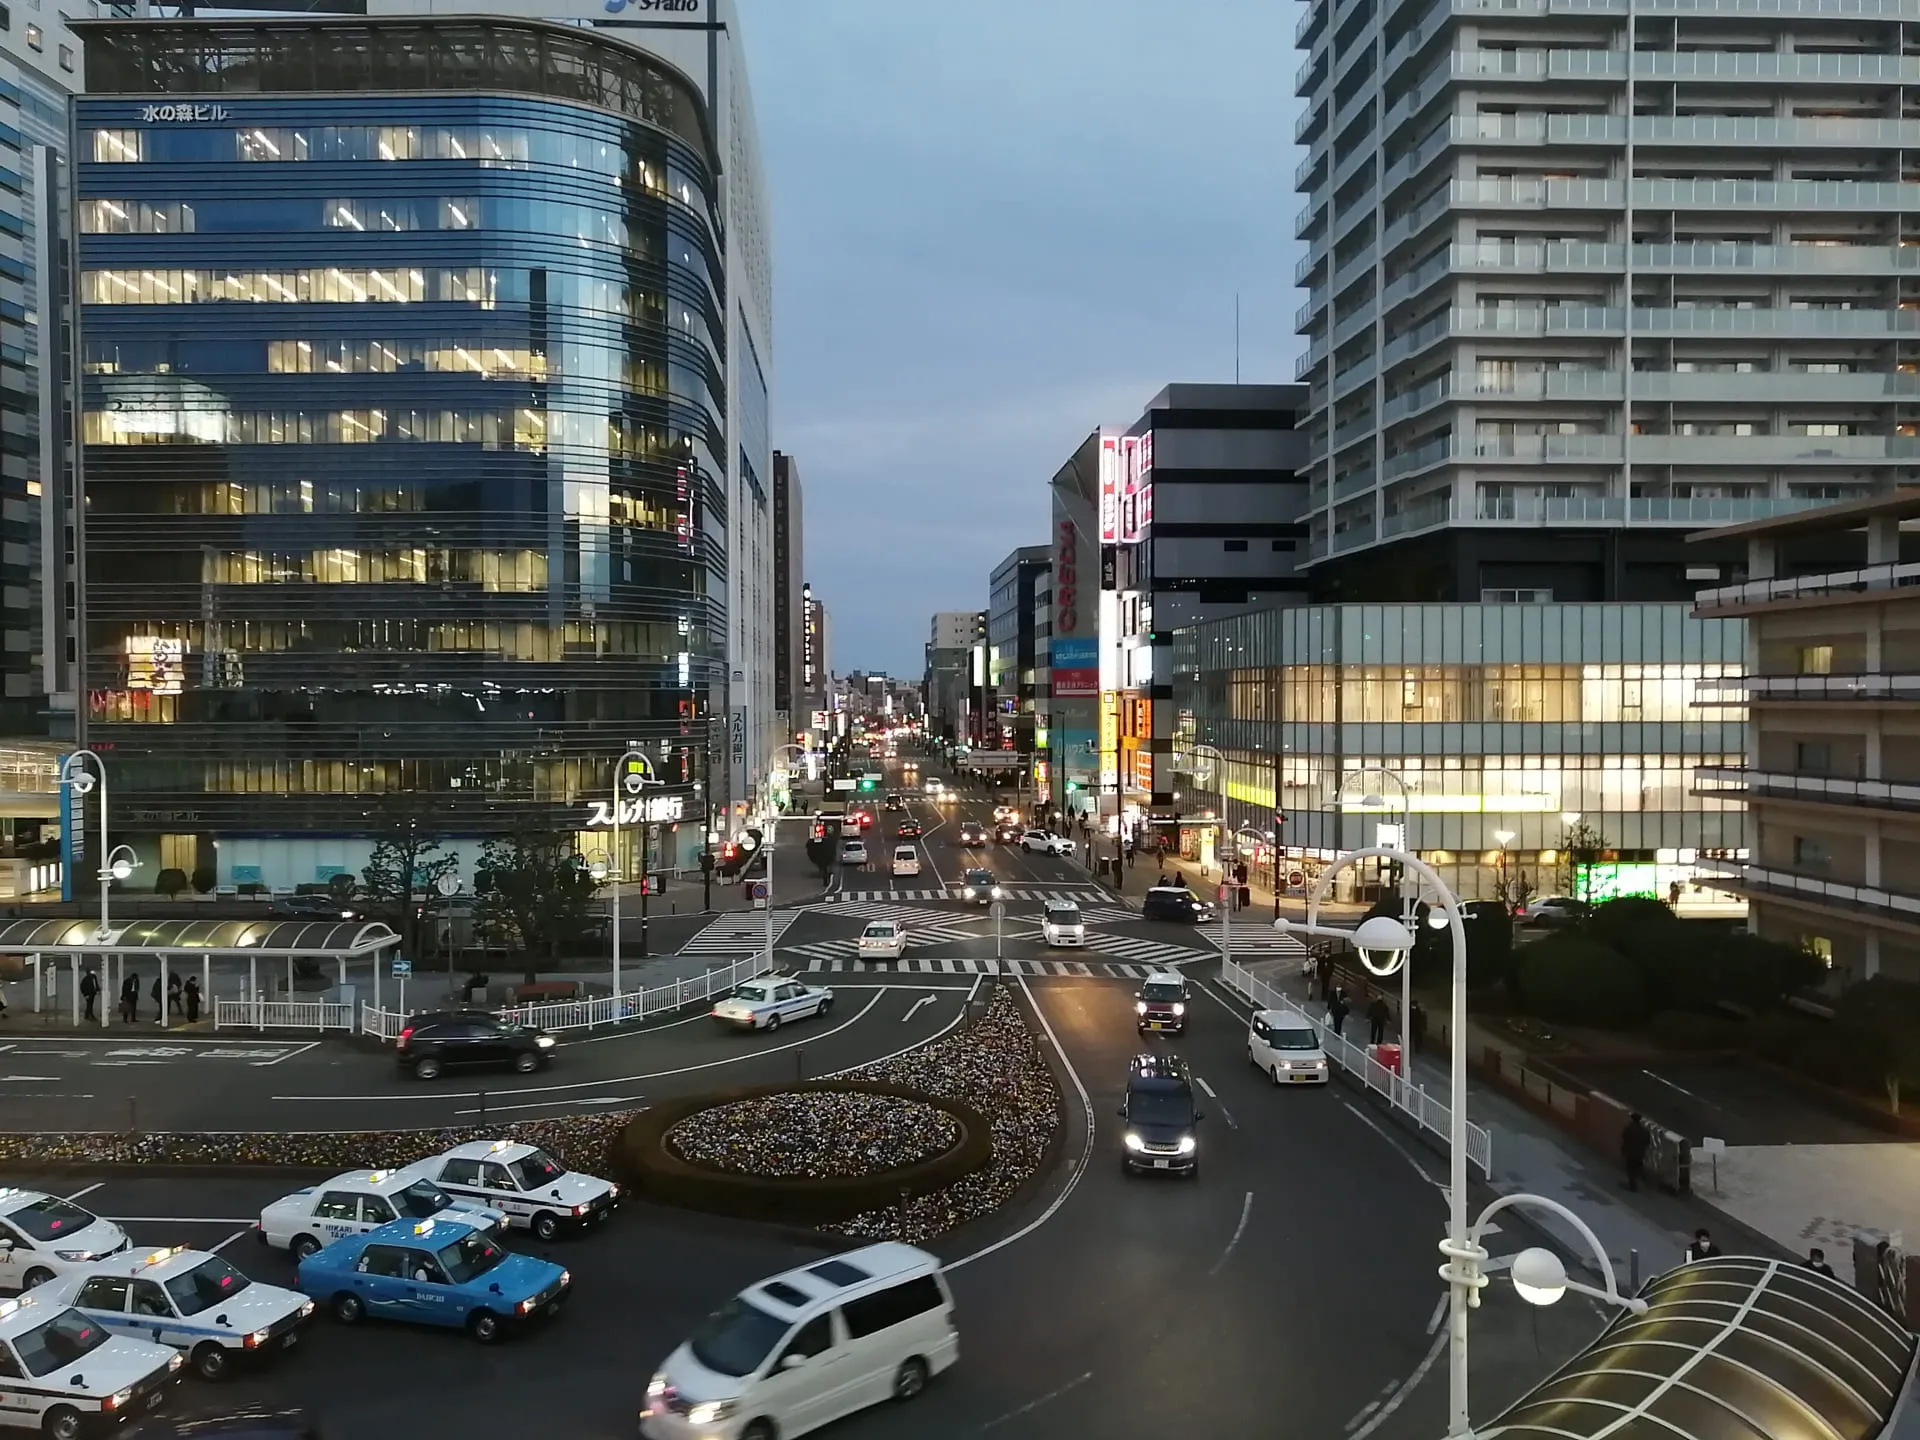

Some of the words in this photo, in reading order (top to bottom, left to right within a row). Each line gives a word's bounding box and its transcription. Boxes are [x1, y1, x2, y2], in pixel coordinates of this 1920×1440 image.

[141, 104, 229, 122] 水の森ビル
[732, 712, 742, 764] スルガ銀行
[586, 796, 683, 825] スルガ銀行
[325, 1224, 352, 1233] HIKARI
